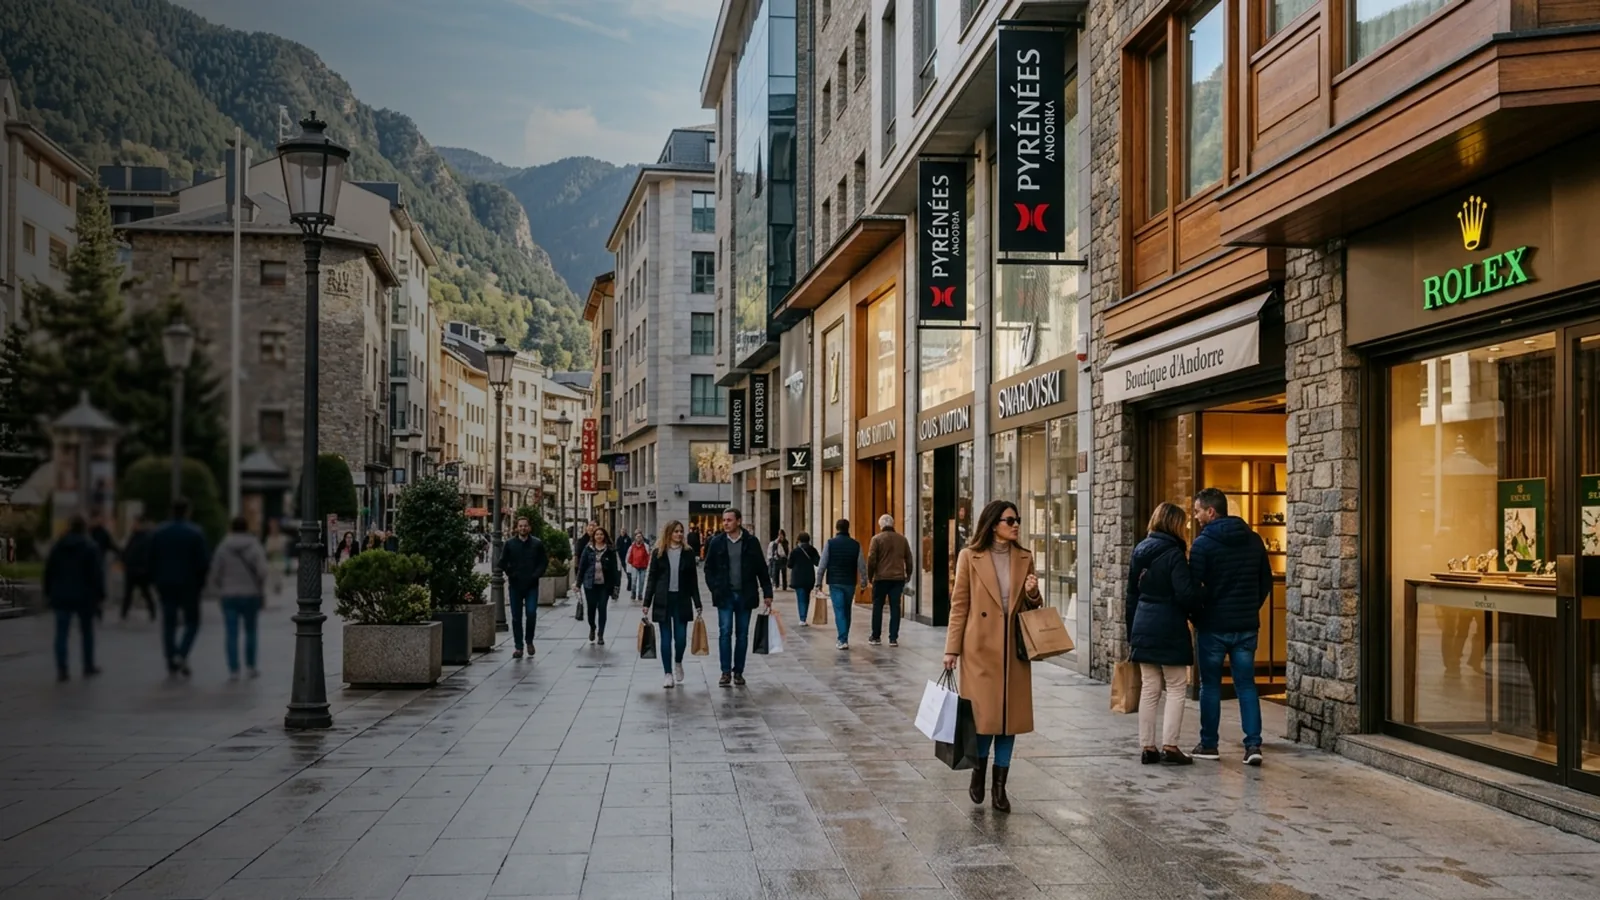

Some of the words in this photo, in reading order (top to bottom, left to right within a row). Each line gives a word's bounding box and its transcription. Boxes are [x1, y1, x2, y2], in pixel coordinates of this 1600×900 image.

[1010, 49, 1040, 192] PYRÉNÉES
[927, 174, 949, 278] PYRÉNÉES
[1422, 246, 1528, 310] ROLEX
[998, 370, 1060, 419] SWAROVSKI
[1169, 347, 1224, 379] d'Andorre
